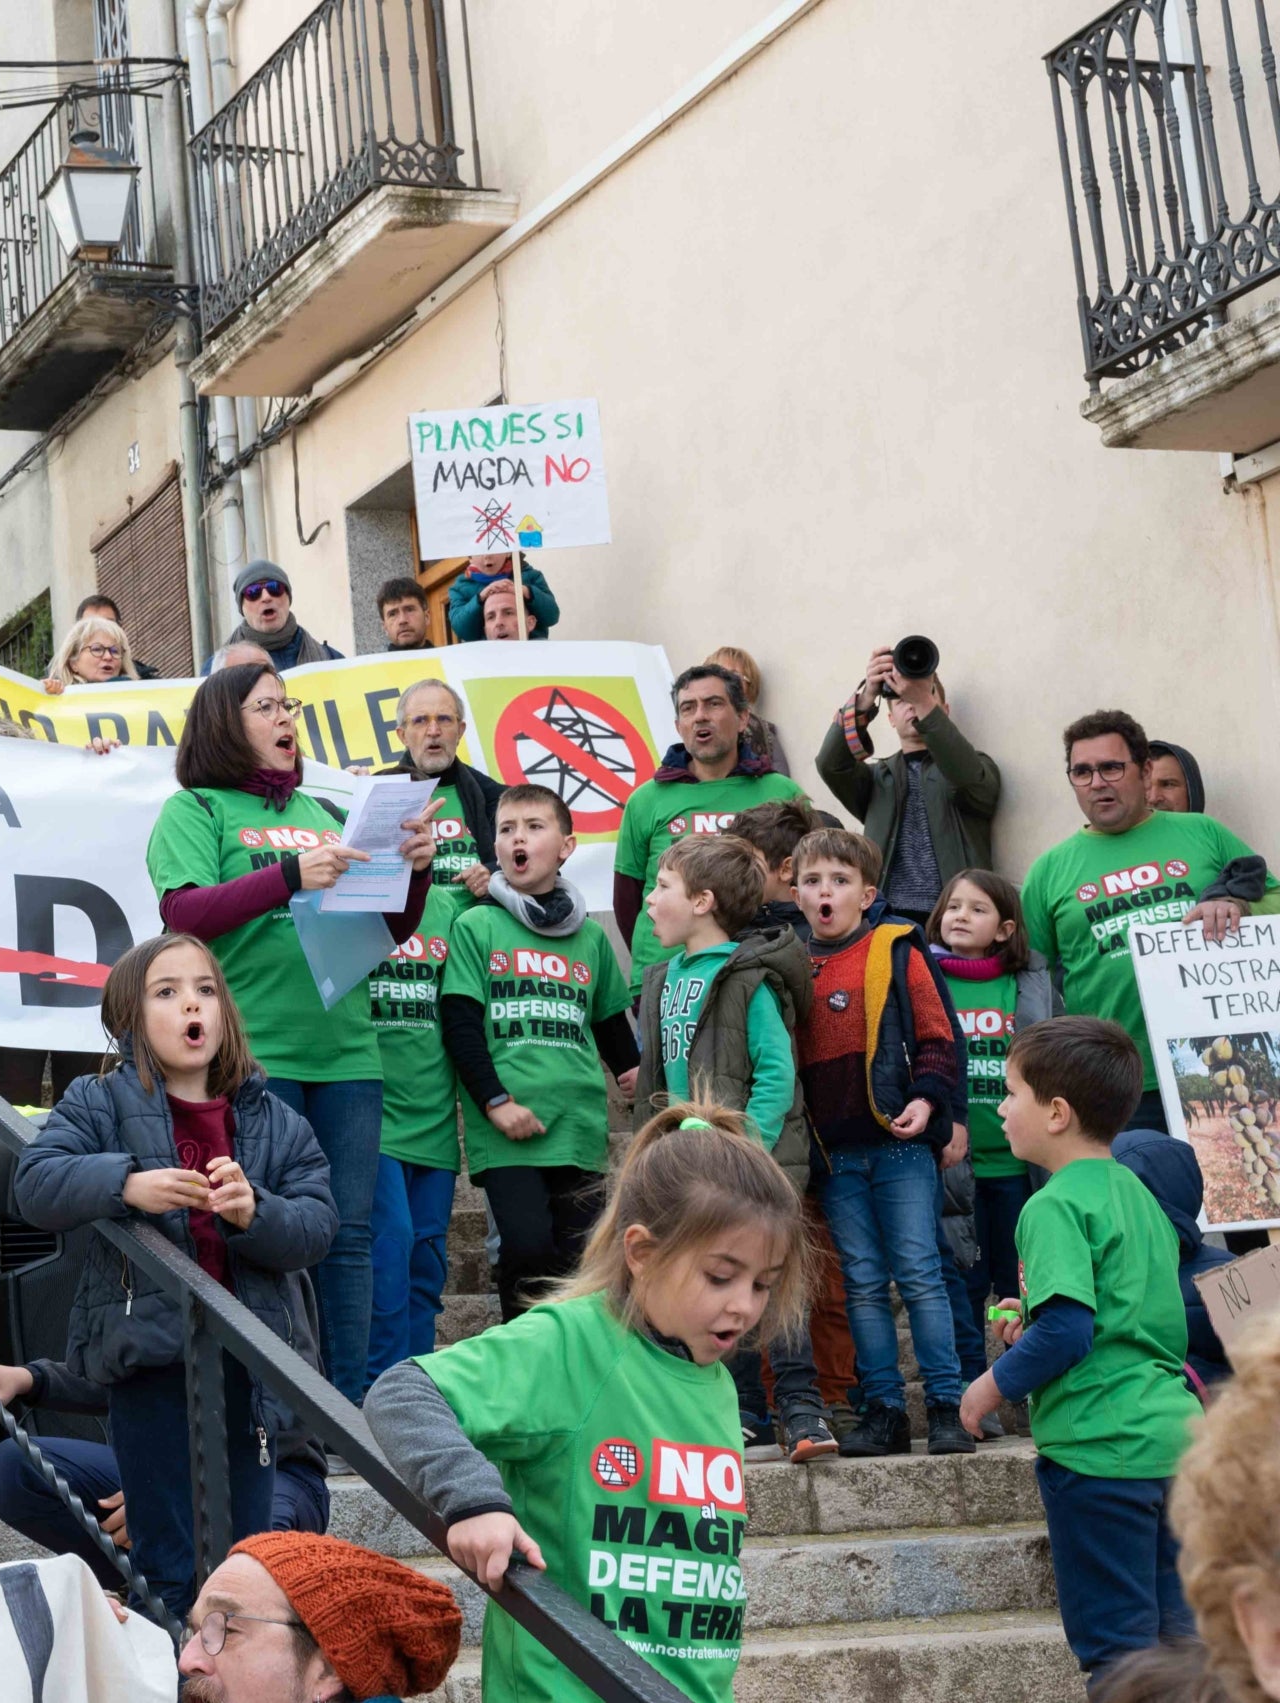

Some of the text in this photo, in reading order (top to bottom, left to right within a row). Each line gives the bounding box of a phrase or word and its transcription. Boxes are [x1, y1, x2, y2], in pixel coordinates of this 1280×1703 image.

[416, 412, 582, 453] PLAQUES SI
[433, 453, 591, 493] MAGDA NO
[265, 828, 320, 848] NO
[1104, 865, 1159, 895] NO
[1084, 881, 1196, 923] MAGDA
[1091, 900, 1197, 941] DEFENSEM
[1135, 924, 1276, 957] DEFENSEM
[517, 951, 567, 978] NO
[1178, 958, 1280, 988] NOSTRA
[491, 979, 588, 1008] MAGDA
[493, 1018, 589, 1046] LA TERRA
[956, 1010, 1002, 1034] NO
[1218, 1267, 1251, 1319] NO
[658, 1446, 743, 1505] NO
[700, 1502, 717, 1520] al
[590, 1593, 650, 1635] LA
